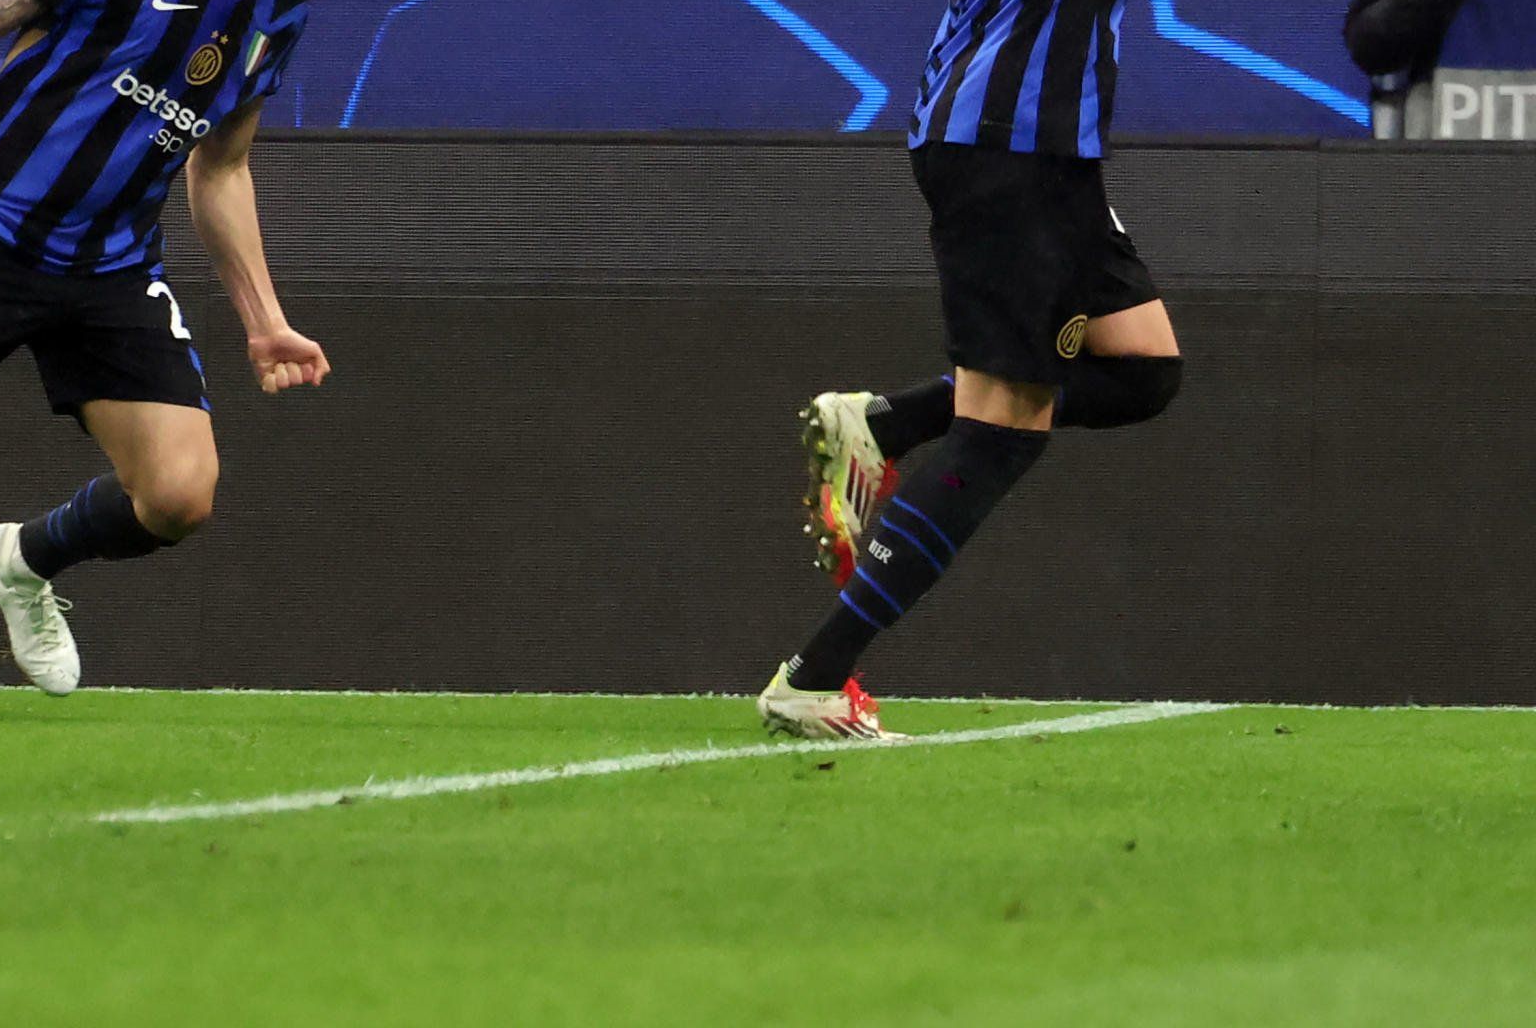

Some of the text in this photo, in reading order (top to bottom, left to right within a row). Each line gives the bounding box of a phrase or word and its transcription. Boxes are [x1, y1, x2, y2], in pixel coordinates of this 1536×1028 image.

[111, 67, 212, 139] betsso
[1439, 82, 1536, 140] PIT
[146, 280, 192, 341] 2
